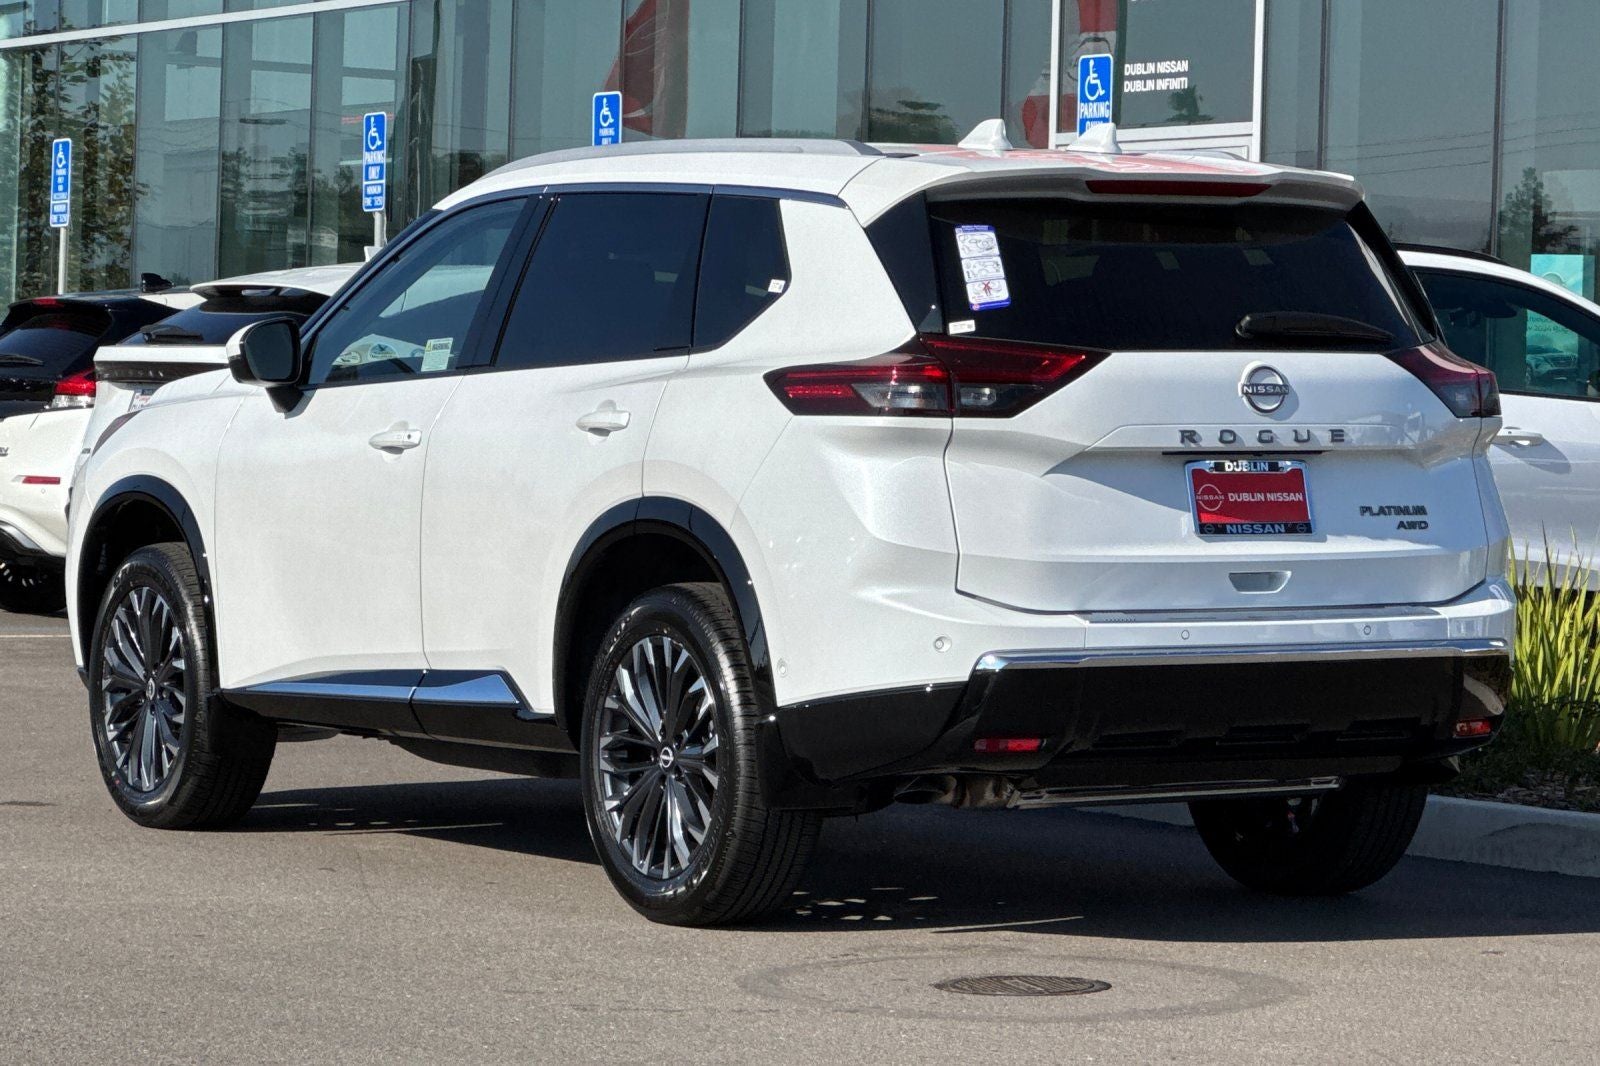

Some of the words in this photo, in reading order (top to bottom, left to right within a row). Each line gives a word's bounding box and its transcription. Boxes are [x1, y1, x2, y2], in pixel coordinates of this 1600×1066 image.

[1124, 62, 1155, 76] DUBLIN
[1156, 60, 1189, 74] NISSAN
[1123, 79, 1155, 93] DUBLIN
[1156, 77, 1188, 91] INFINITI
[1080, 101, 1110, 118] PARKING
[1243, 384, 1289, 395] NISSAN
[1179, 429, 1346, 444] ROGUE
[1225, 462, 1269, 472] DUBLIN
[1228, 492, 1265, 502] DUBLIN
[1267, 492, 1303, 502] NISSAN
[1359, 505, 1428, 516] PLATINUM
[1226, 523, 1286, 534] NISSAN
[1396, 520, 1429, 530] AWD
